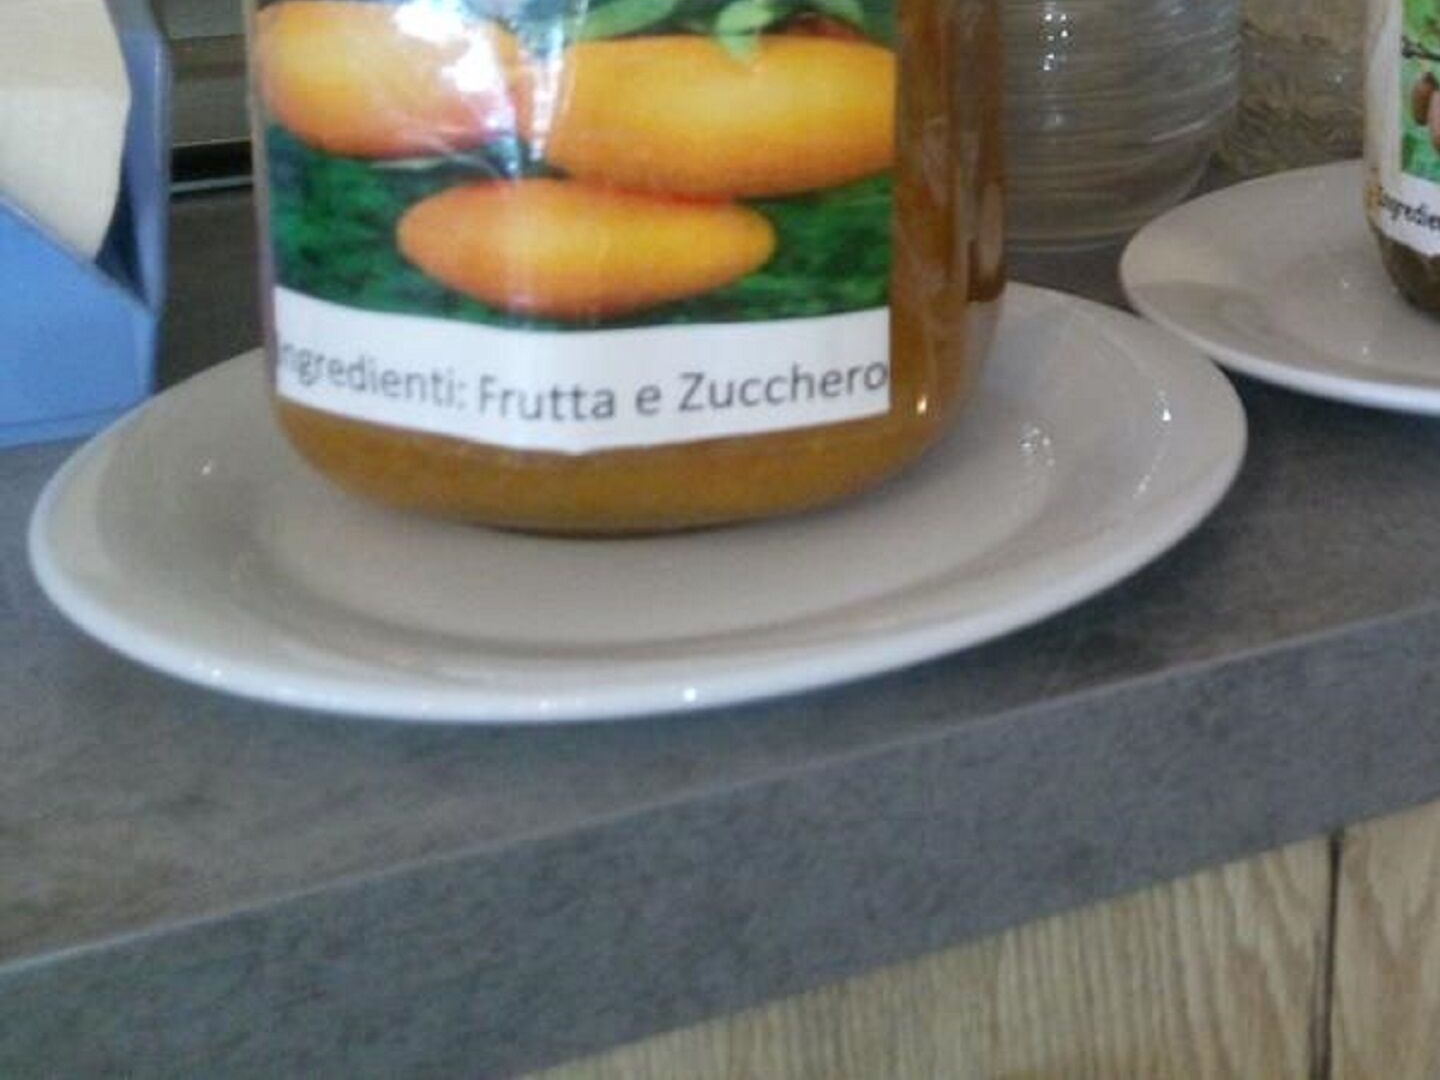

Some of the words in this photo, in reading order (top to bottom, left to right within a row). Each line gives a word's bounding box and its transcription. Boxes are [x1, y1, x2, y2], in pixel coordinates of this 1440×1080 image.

[478, 375, 616, 420] Frutta
[635, 384, 662, 416] e
[679, 360, 888, 413] Zucchero
